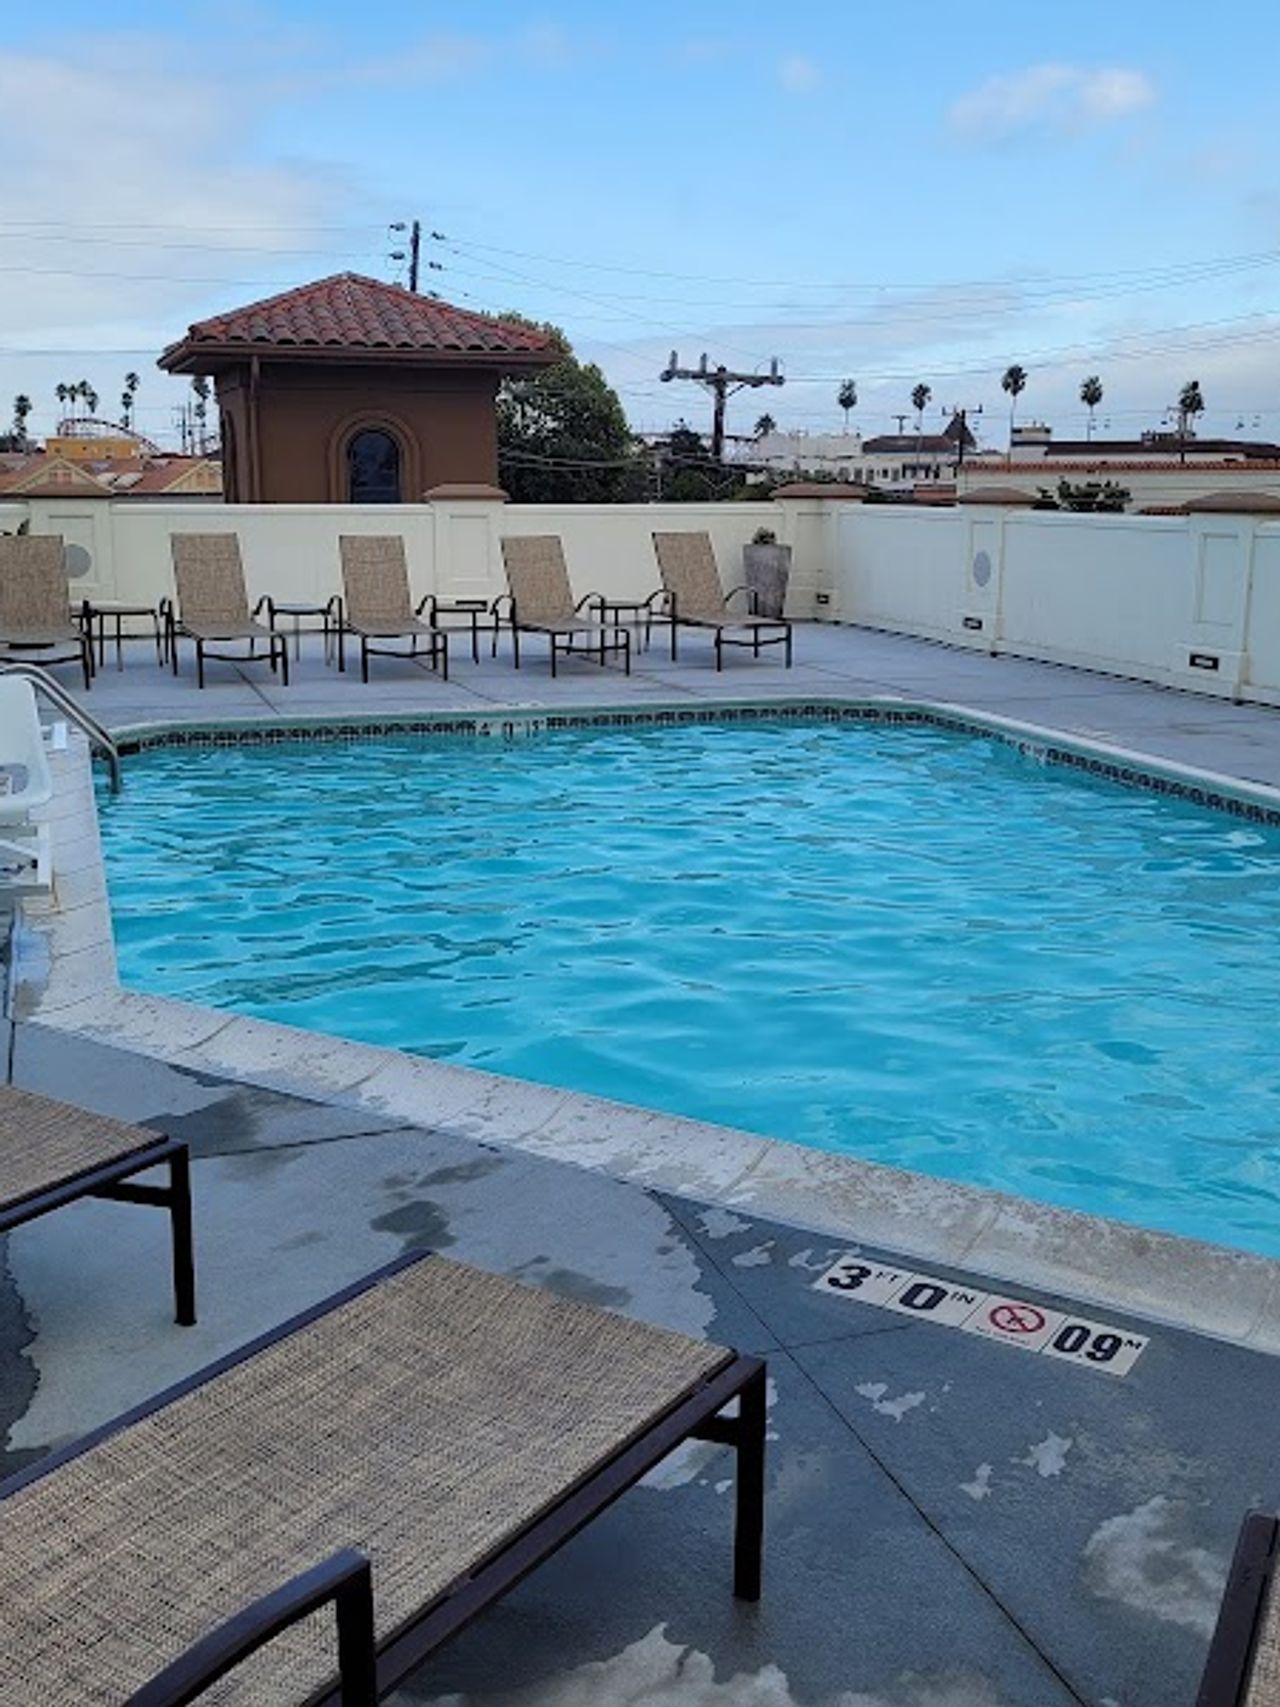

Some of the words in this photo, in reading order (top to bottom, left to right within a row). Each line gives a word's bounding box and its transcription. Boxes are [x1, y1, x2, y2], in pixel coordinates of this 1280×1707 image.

[828, 1265, 872, 1290] 3
[899, 1283, 949, 1310] 0
[950, 1291, 976, 1305] IN
